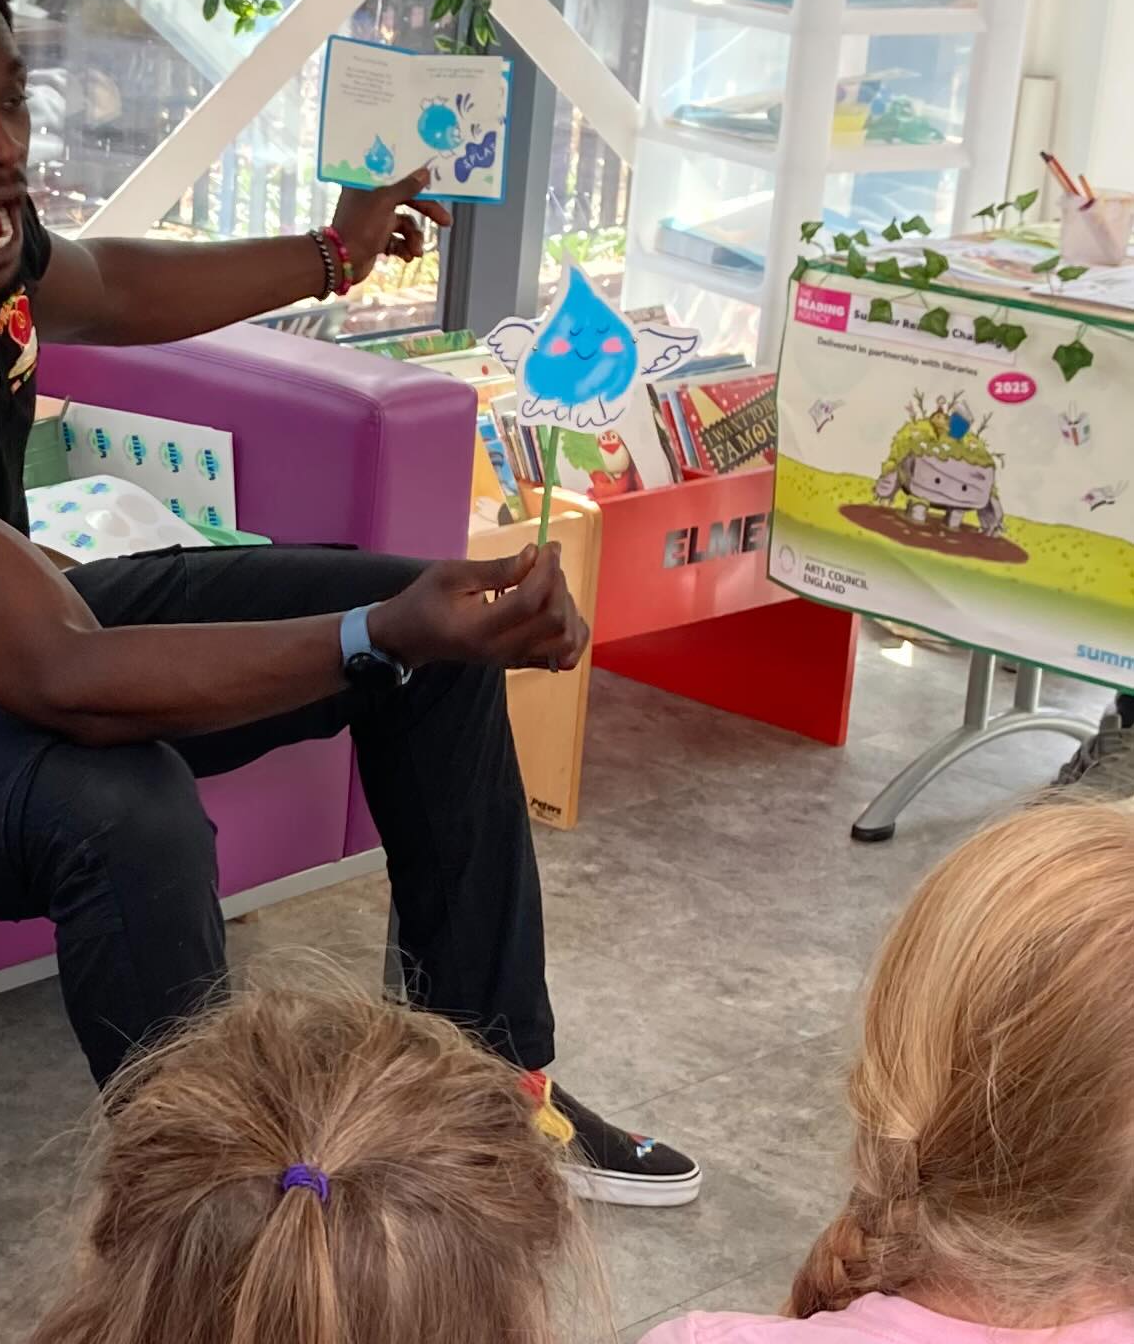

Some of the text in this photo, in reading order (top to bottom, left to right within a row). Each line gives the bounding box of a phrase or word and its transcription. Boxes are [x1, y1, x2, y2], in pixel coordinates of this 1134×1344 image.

[798, 297, 845, 317] READING
[817, 336, 978, 376] Delivered in partnership with libraries
[994, 381, 1029, 394] 2025
[705, 433, 714, 447] I
[712, 413, 748, 441] WANT
[746, 404, 764, 421] TO
[95, 427, 107, 458] WATER
[131, 435, 143, 466] WATER
[167, 442, 179, 473] WATER
[711, 415, 778, 469] FAMOU
[204, 449, 216, 481] WATER
[803, 573, 846, 594] ENGLAND
[805, 562, 826, 577] ARTS
[828, 569, 869, 591] COUNCIL
